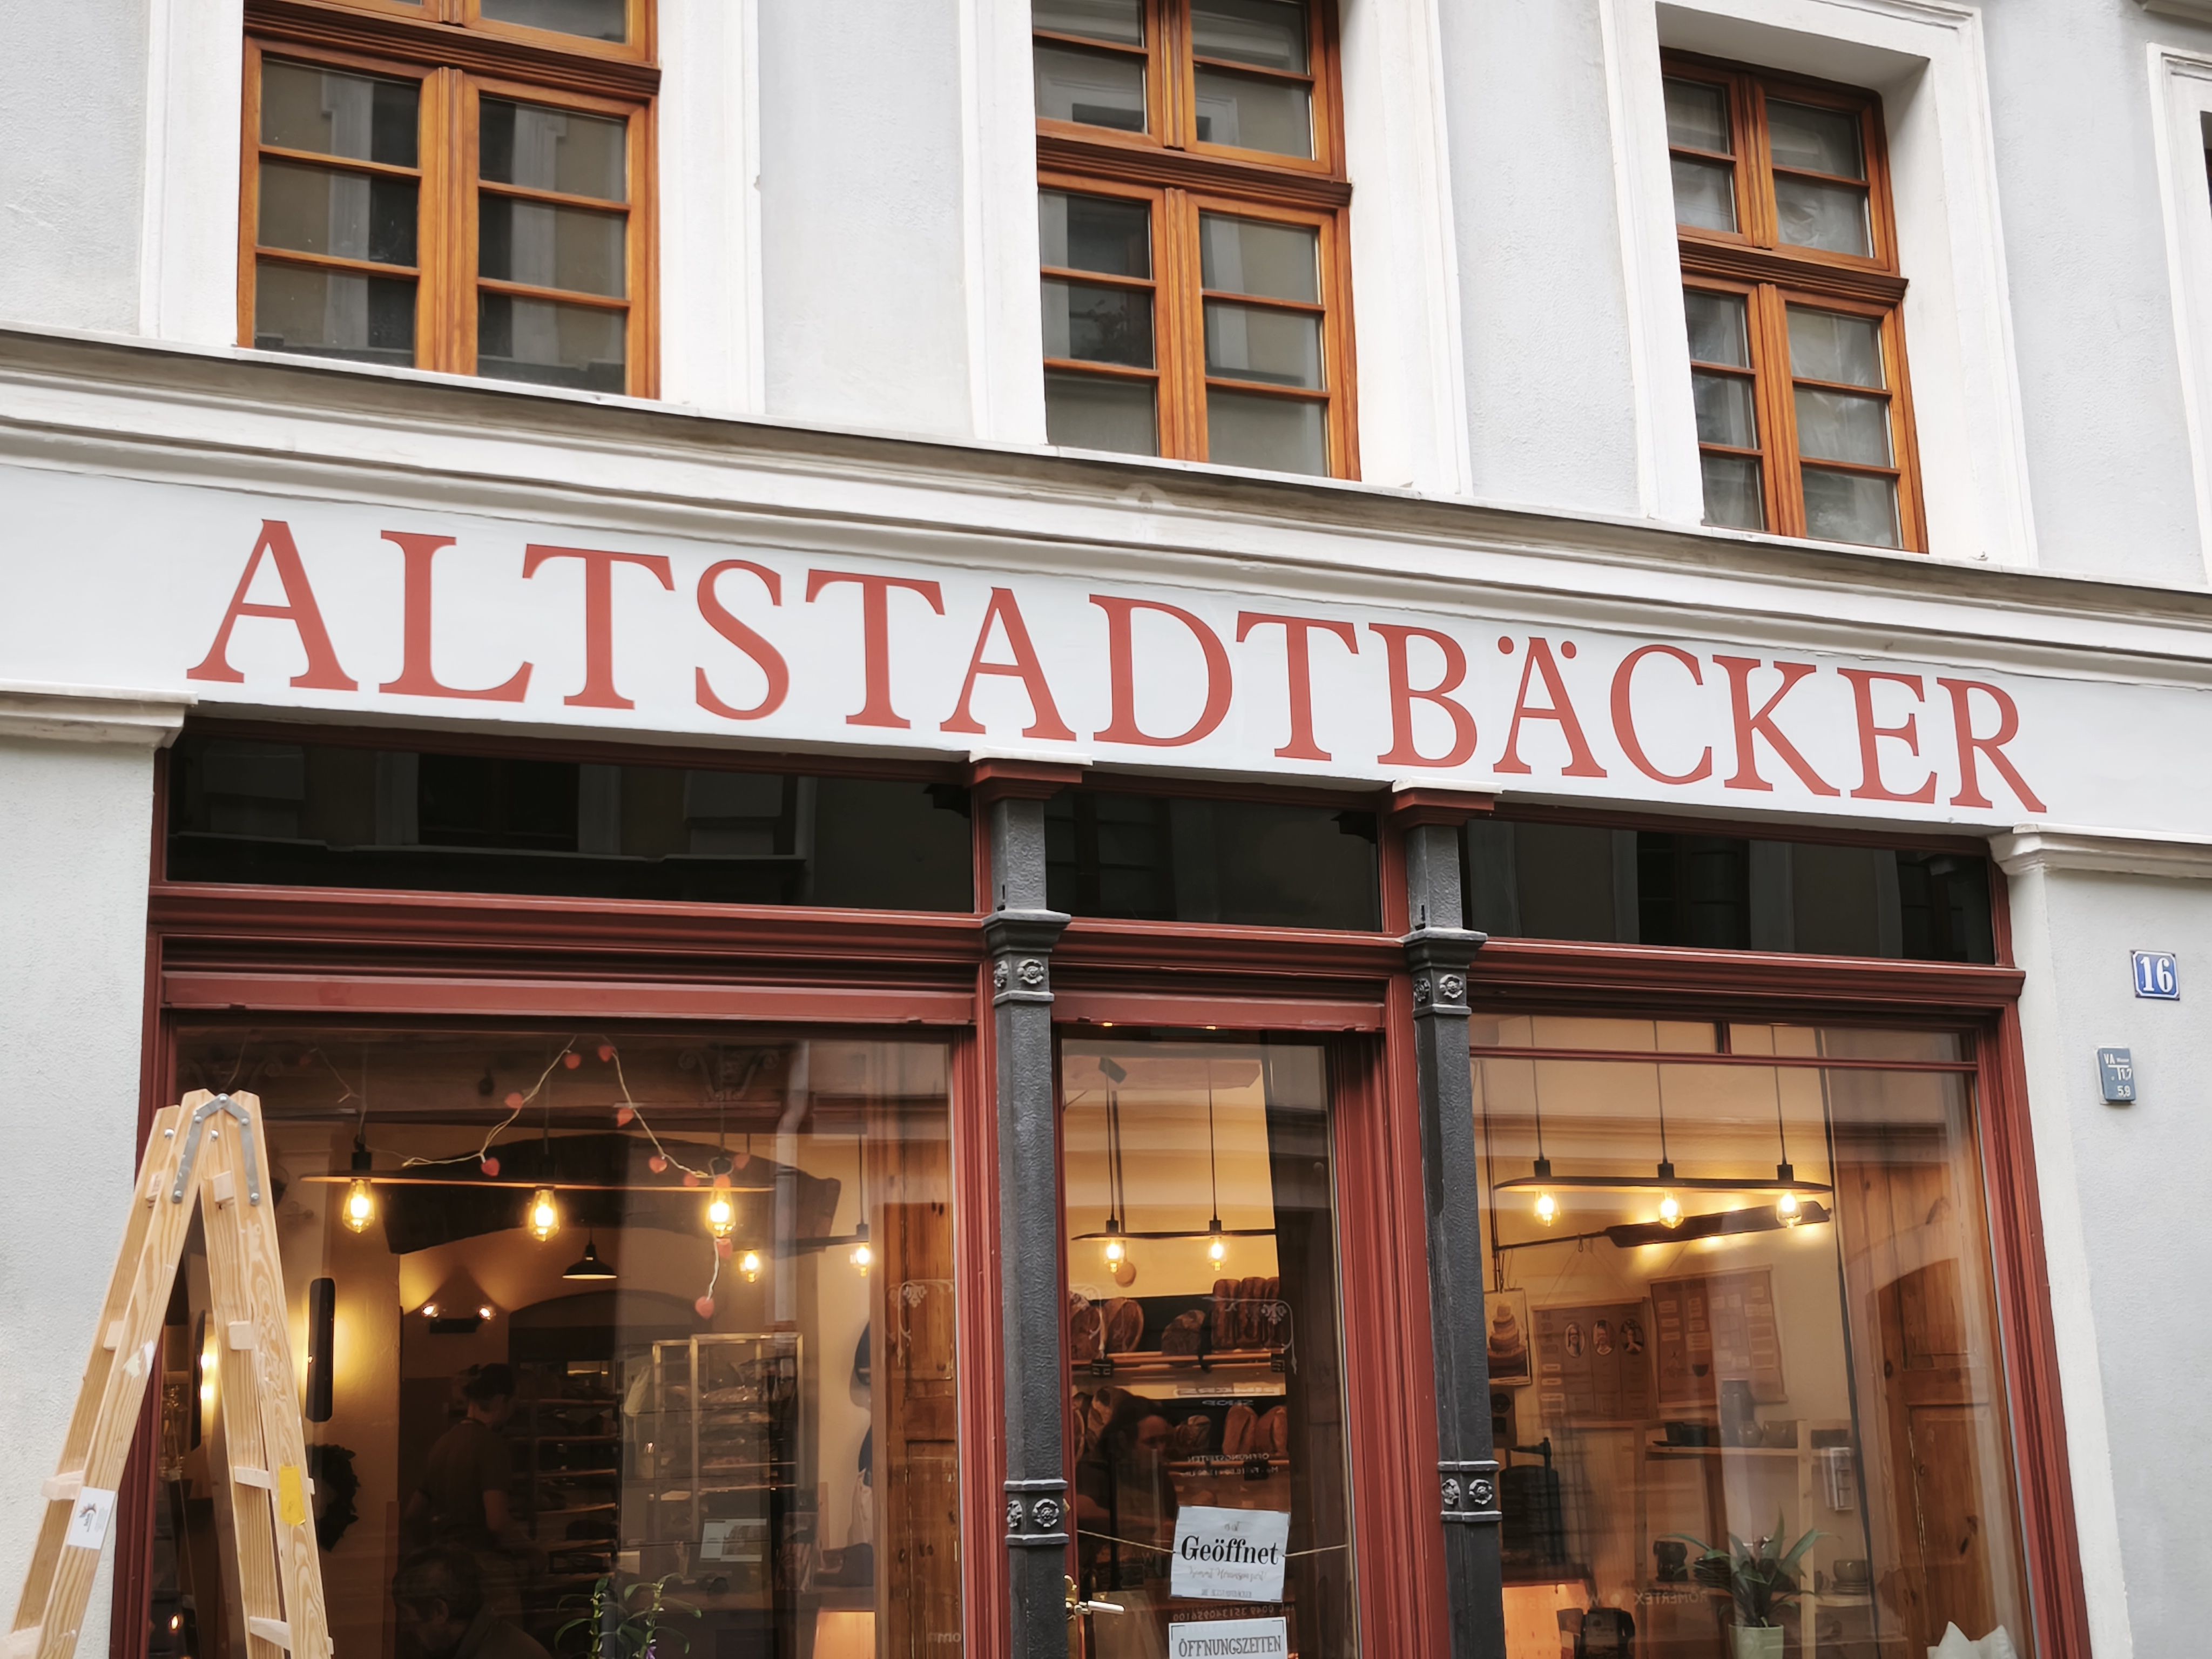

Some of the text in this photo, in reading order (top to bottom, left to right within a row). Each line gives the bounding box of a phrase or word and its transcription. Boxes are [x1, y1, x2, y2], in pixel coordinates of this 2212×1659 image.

[188, 521, 2046, 813] ALTSTADTBÄCKER
[2140, 956, 2173, 993] 16
[2103, 1054, 2115, 1064] VA
[1181, 1535, 1278, 1565] Geöffnet
[1178, 1636, 1282, 1657] ÖFFNUNGSZEITEN
